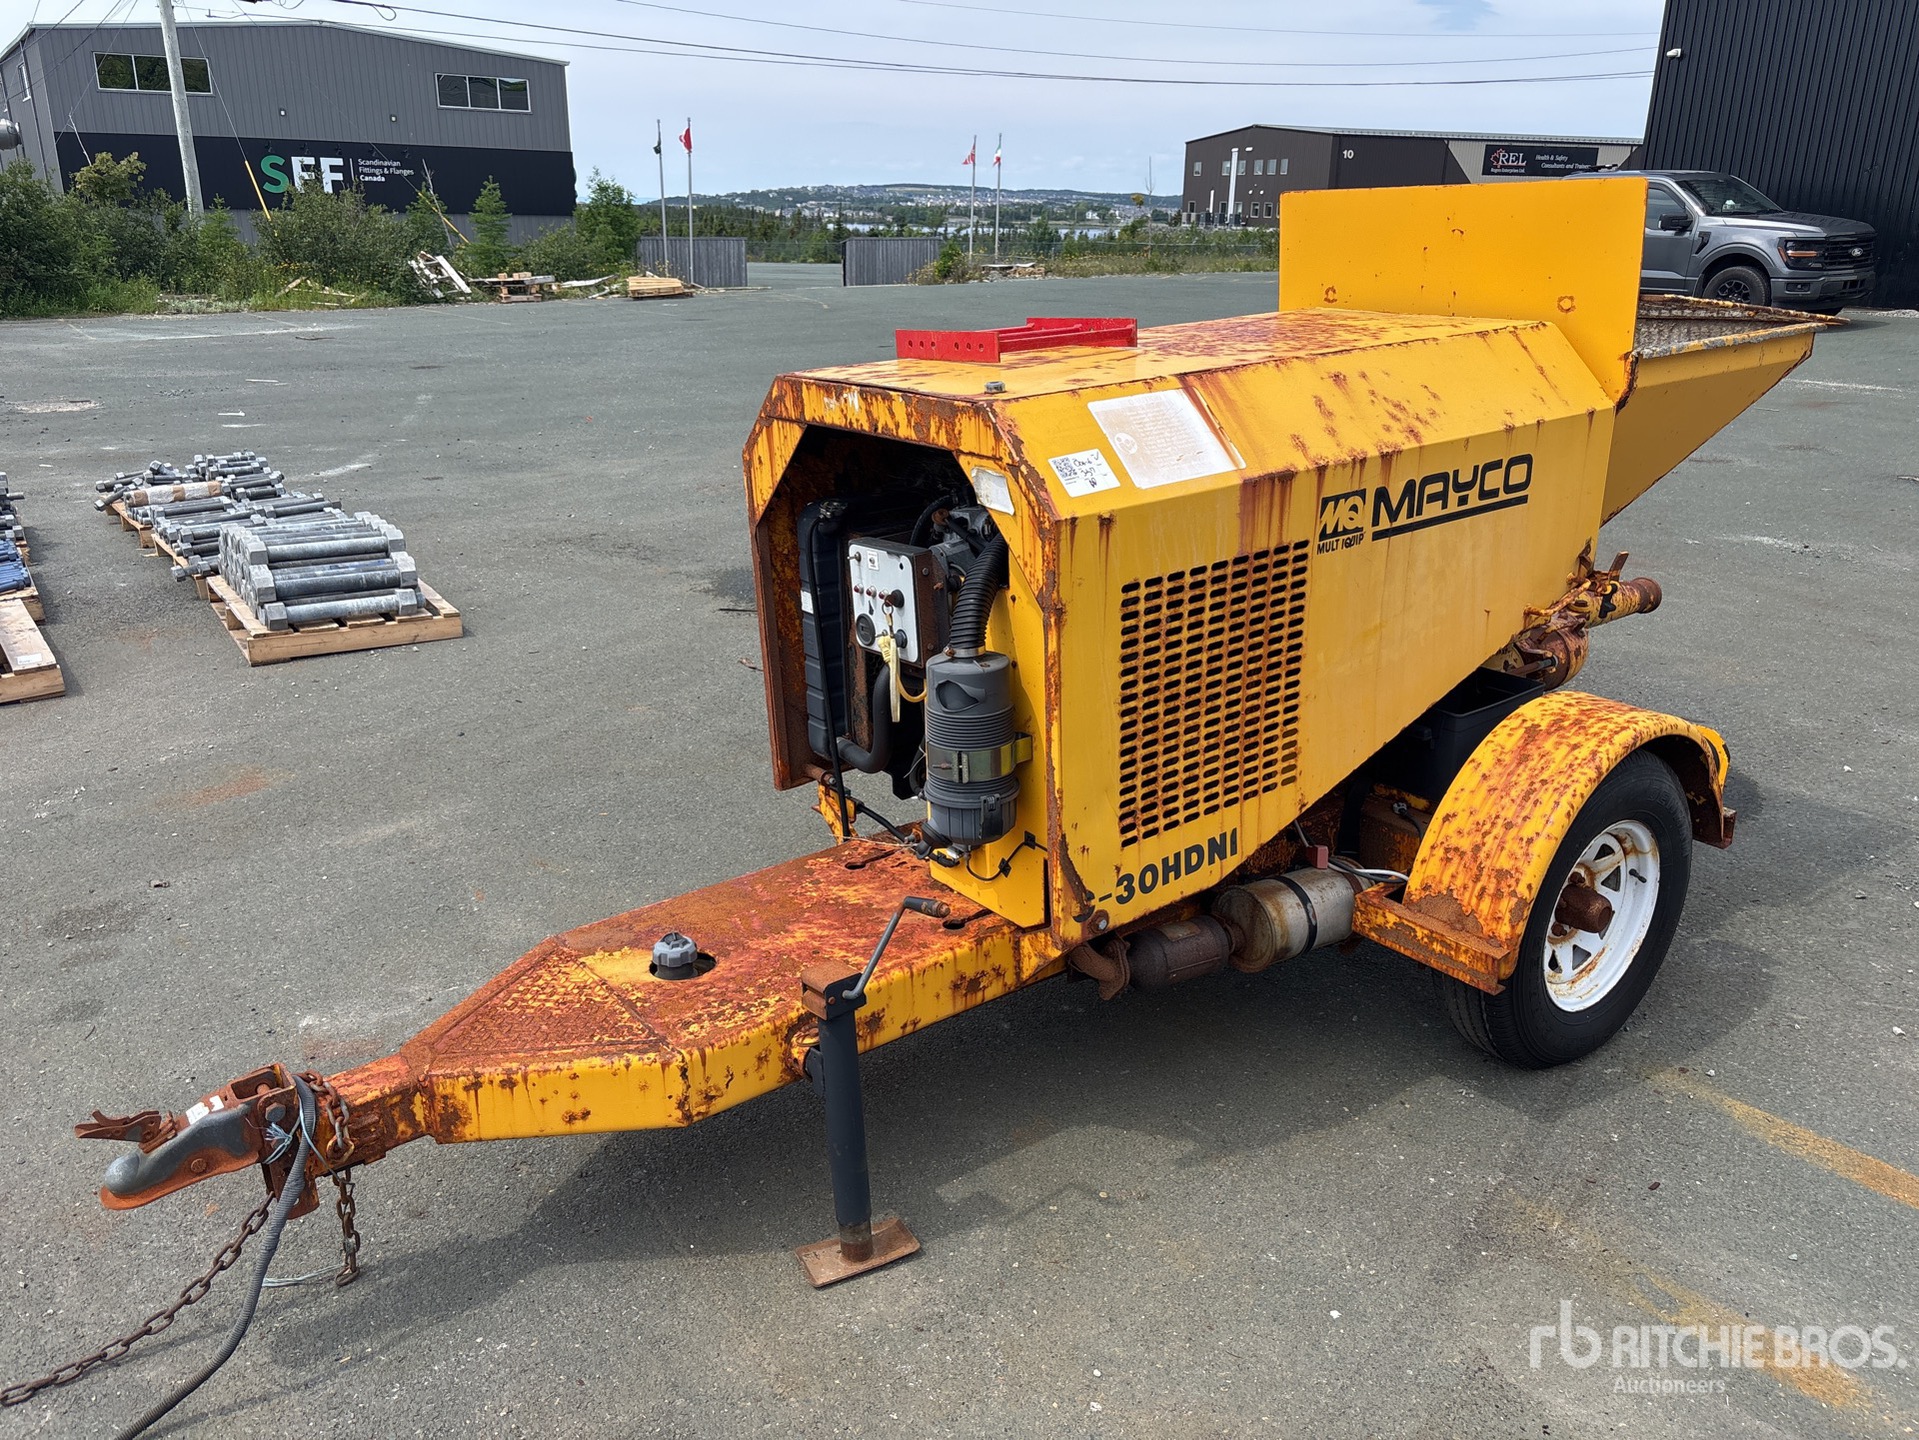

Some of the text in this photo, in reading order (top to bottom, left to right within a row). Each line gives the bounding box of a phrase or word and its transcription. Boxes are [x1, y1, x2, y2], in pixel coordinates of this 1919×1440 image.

[1342, 149, 1355, 160] 10
[1499, 152, 1527, 166] REL
[358, 158, 401, 167] Scandinavian
[260, 155, 344, 193] SFF
[359, 167, 383, 176] Fittings
[390, 168, 414, 177] Flanges
[1371, 453, 1534, 528] MAYCO
[1319, 488, 1366, 542] MQ
